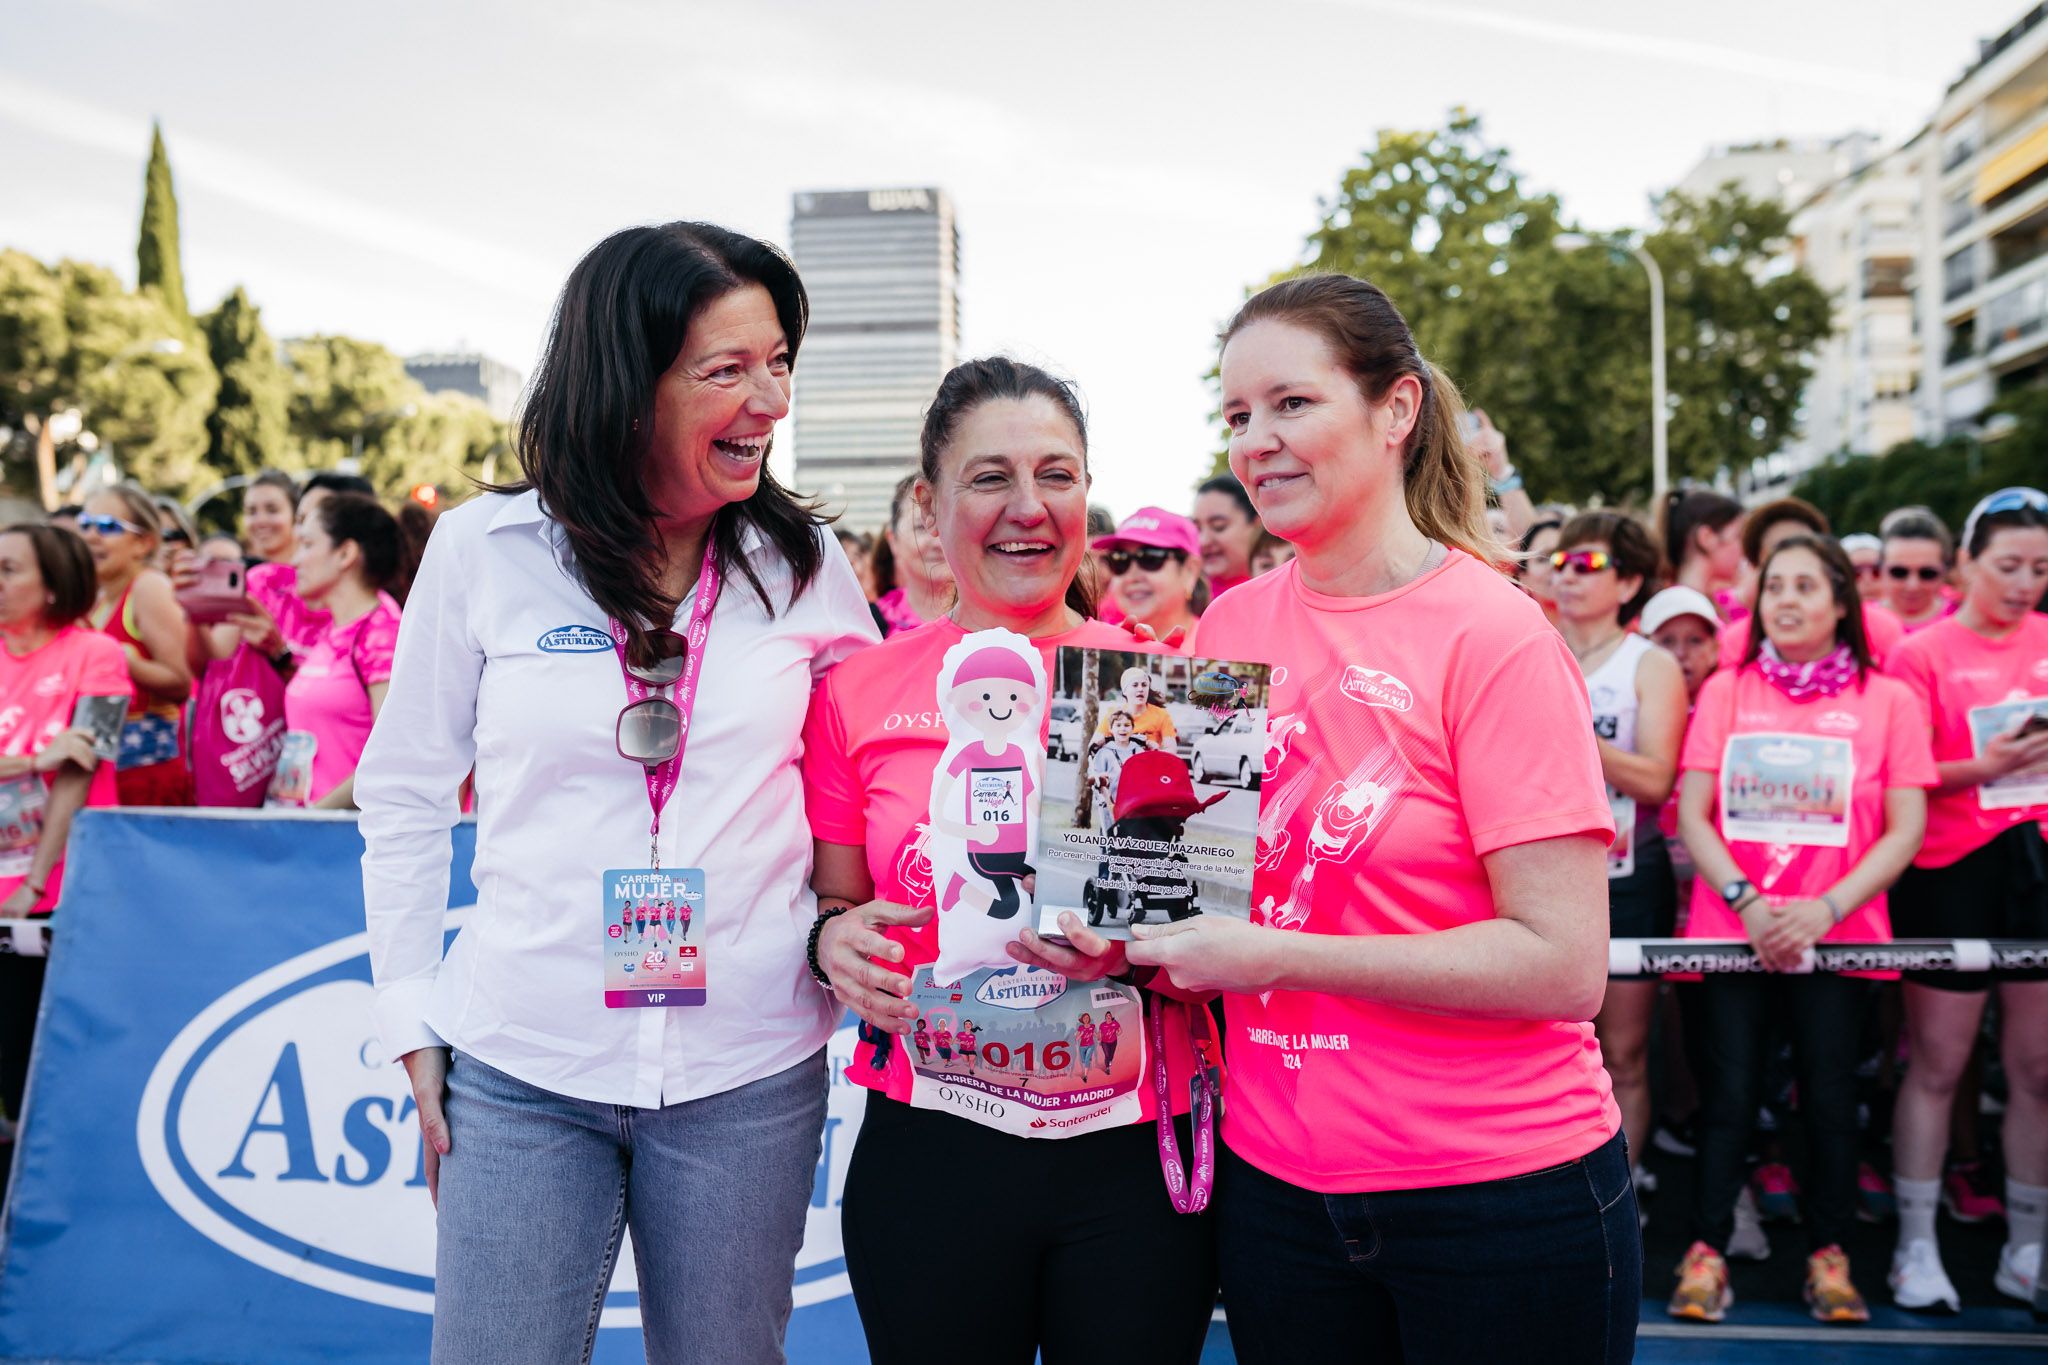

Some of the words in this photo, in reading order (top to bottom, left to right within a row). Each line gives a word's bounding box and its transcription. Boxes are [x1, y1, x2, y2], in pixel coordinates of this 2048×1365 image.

[544, 636, 609, 648] ASTURIANA
[983, 809, 1010, 822] 016
[1063, 833, 1115, 847] YOLANDA
[1117, 836, 1168, 851] VÁZQUEZ
[1170, 843, 1235, 858] MAZARIEGO
[1048, 849, 1062, 857] Por
[1086, 853, 1108, 862] hacer
[1109, 856, 1133, 865] crecer
[1141, 859, 1162, 867] sentir
[1173, 861, 1202, 871] Carrera
[1203, 864, 1213, 872] de
[1215, 865, 1222, 873] la
[1224, 866, 1246, 876] Mujer
[1109, 864, 1133, 874] desde
[1143, 868, 1167, 877] primer
[620, 874, 671, 884] CARRERA
[1097, 879, 1126, 890] Madrid,
[1128, 882, 1137, 890] 12
[1138, 883, 1149, 891] de
[1150, 885, 1172, 895] mayo
[1173, 886, 1192, 895] 2024
[614, 882, 687, 899] MUJER
[614, 950, 639, 958] OYSHO
[646, 951, 664, 963] 20
[1652, 954, 1767, 973] ORREDOR
[647, 993, 666, 1003] VIP
[1292, 1033, 1309, 1050] LA
[1311, 1033, 1350, 1051] MUJER
[982, 1040, 1071, 1071] 016
[1019, 1077, 1029, 1087] 7
[938, 1074, 987, 1091] CARRERA
[989, 1085, 1004, 1096] DE
[1007, 1088, 1021, 1099] LA
[1024, 1091, 1061, 1107] MUJER
[1070, 1088, 1114, 1104] MADRID
[939, 1086, 1005, 1118] OYSHO
[1049, 1105, 1113, 1128] Santander
